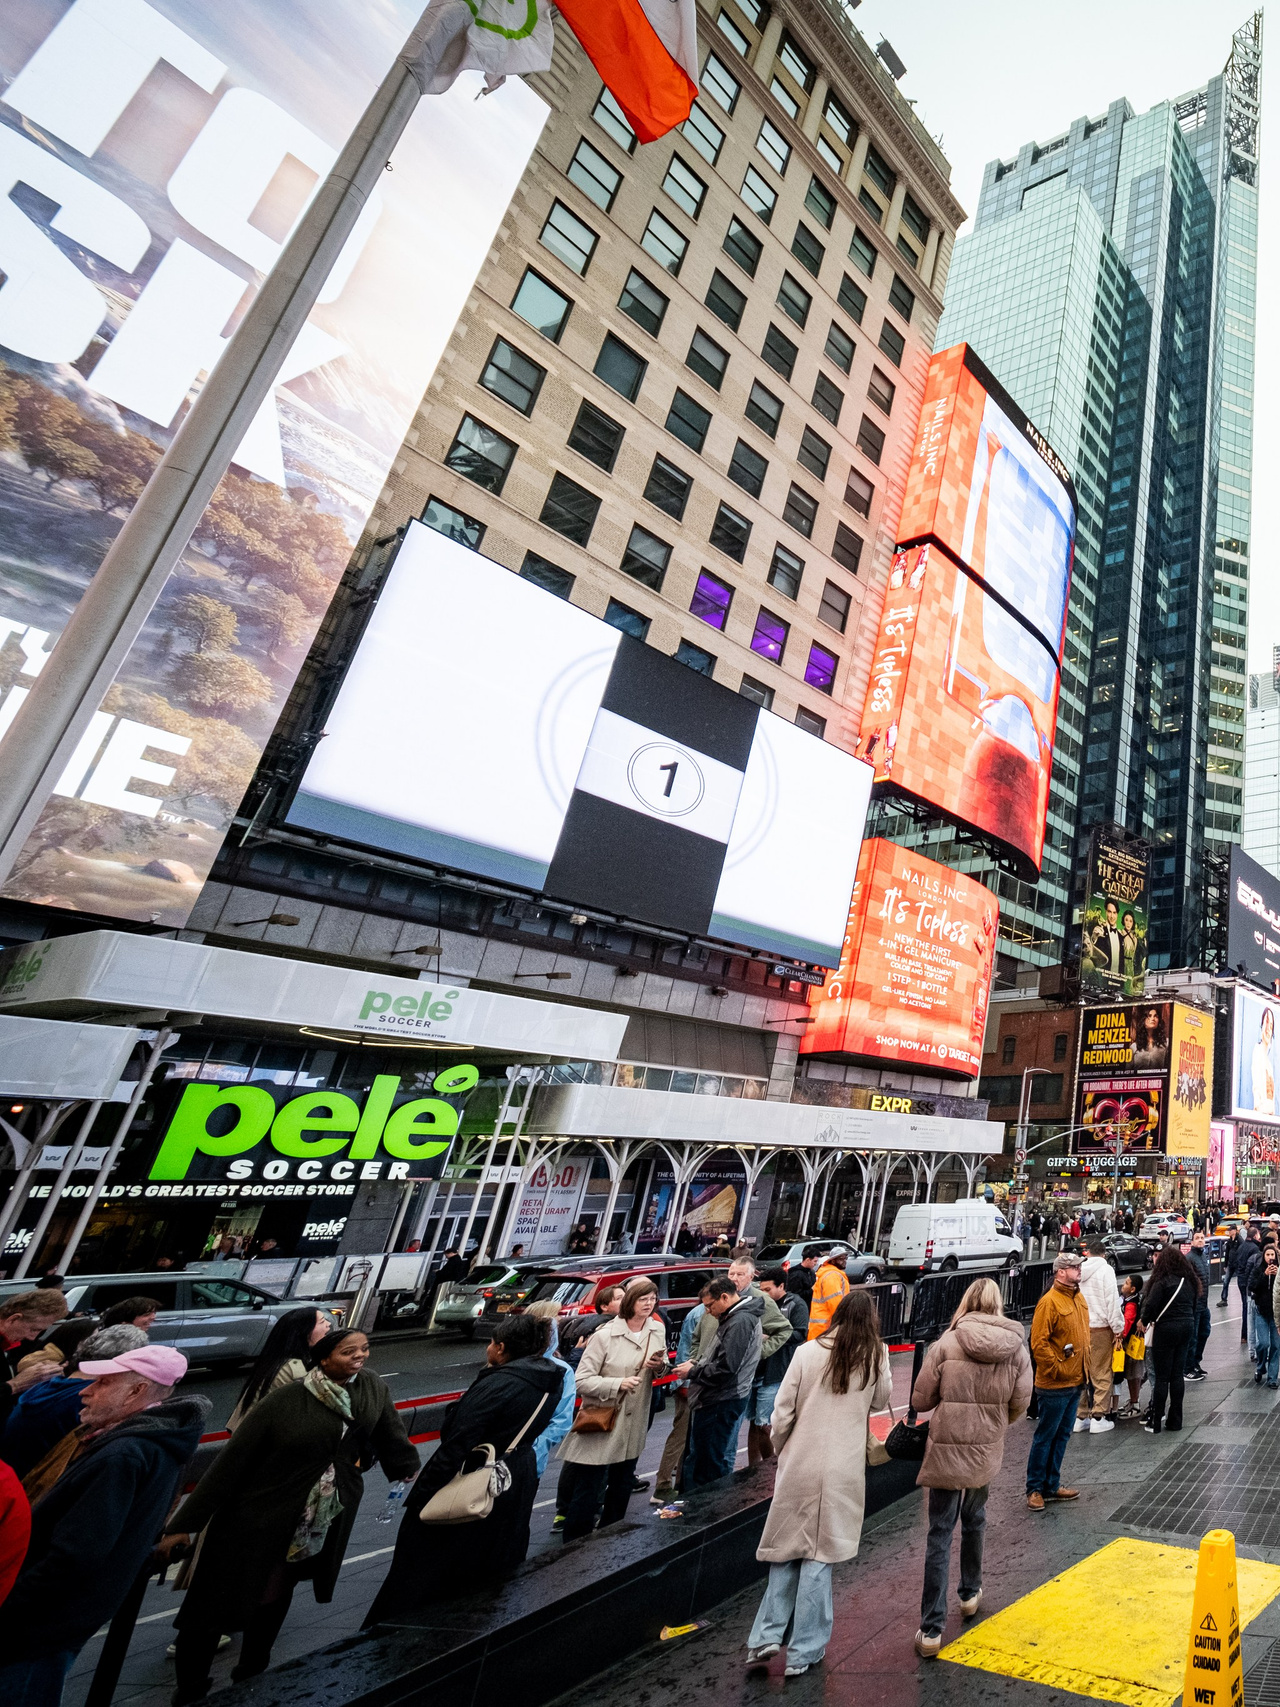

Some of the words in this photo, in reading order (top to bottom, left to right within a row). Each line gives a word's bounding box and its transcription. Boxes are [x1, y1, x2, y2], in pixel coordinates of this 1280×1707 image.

[871, 640, 907, 713] Topless
[659, 761, 679, 797] 1
[1098, 863, 1114, 880] THE
[1116, 870, 1145, 891] GREAT
[918, 889, 947, 906] LONDON
[1102, 878, 1140, 902] GATSBY
[879, 886, 911, 925] It's
[915, 900, 969, 946] Topless
[878, 937, 903, 952] 4-IN-1
[904, 945, 919, 957] GEL
[894, 933, 915, 947] NEW
[915, 938, 930, 951] THE
[931, 945, 952, 957] FIRST
[890, 961, 911, 973] COLOR
[911, 967, 924, 975] AND
[924, 970, 935, 978] TOP
[934, 974, 948, 982] COAT
[892, 973, 911, 986] STEP
[921, 982, 948, 995] BOTTLE
[358, 990, 460, 1022] pelé
[379, 1015, 431, 1028] SOCCER
[1096, 1012, 1126, 1029] IDINA
[1087, 1028, 1131, 1045] MENZEL
[876, 1035, 900, 1047] SHOP
[900, 1039, 920, 1051] NOW
[920, 1044, 930, 1052] AT
[948, 1047, 971, 1062] TARGET
[1083, 1048, 1133, 1065] REDWOOD
[1180, 1040, 1205, 1063] OPERATION
[1127, 1080, 1135, 1090] LIFE
[1136, 1080, 1148, 1089] AFTER
[871, 1094, 936, 1116] EXPRESS
[148, 1065, 479, 1180] pelé
[226, 1158, 411, 1181] SOCCER
[1047, 1157, 1077, 1166] GIFTS
[1085, 1156, 1138, 1167] LUGGAGE
[144, 1184, 237, 1198] GREATEST
[240, 1184, 304, 1197] SOCCER
[306, 1183, 355, 1196] STORE
[520, 1207, 571, 1216] RESTURANT
[302, 1216, 348, 1237] pelé
[1194, 1634, 1221, 1651] CAUTION
[1193, 1654, 1221, 1672] CUIDADO
[1194, 1687, 1216, 1705] WET
